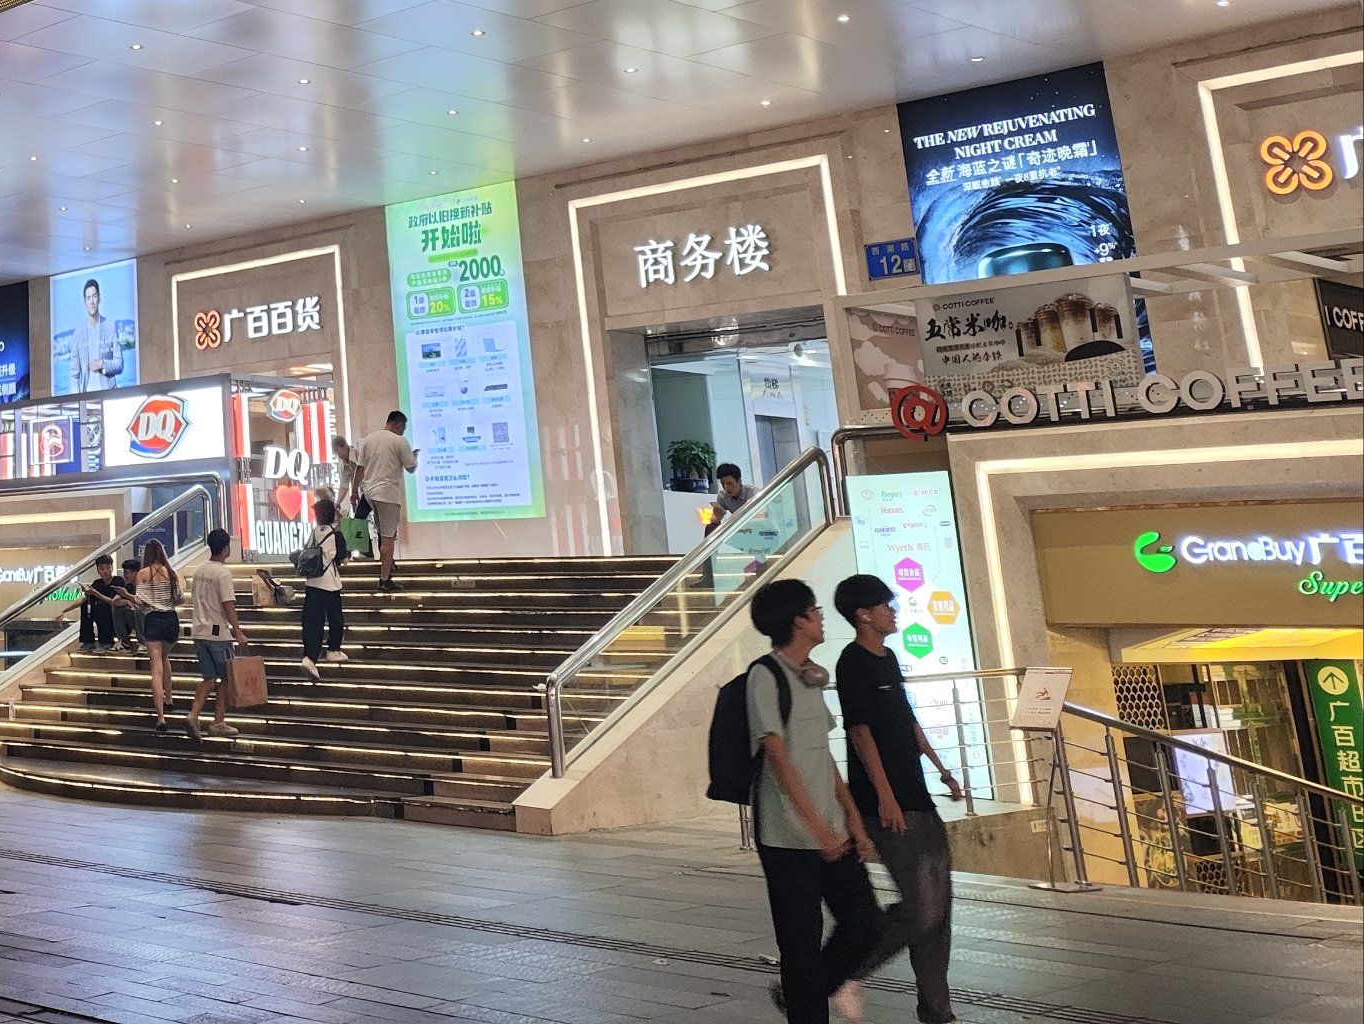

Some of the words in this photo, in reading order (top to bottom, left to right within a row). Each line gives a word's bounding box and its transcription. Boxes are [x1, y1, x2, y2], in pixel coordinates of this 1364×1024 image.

[913, 133, 946, 150] THE
[947, 126, 982, 144] NEW
[981, 103, 1096, 136] REJUVENATING
[955, 140, 1002, 160] NIGHT
[1003, 129, 1058, 151] CREAM
[926, 166, 955, 184] 全新
[408, 201, 493, 229] 政府以旧换新补贴
[421, 220, 482, 253] 开始啦
[458, 255, 502, 282] 2000
[634, 223, 772, 289] 商务楼
[223, 295, 322, 343] 广百百货
[429, 301, 451, 314] 20%
[942, 301, 965, 311] COTTI
[965, 298, 995, 308] COFFEE
[941, 350, 1003, 367] 中国人的拿铁
[961, 378, 1119, 428] COTTI
[1138, 356, 1363, 415] COFFEE
[137, 409, 174, 443] DQ
[263, 445, 311, 486] DQ
[887, 543, 914, 553] Wyeth
